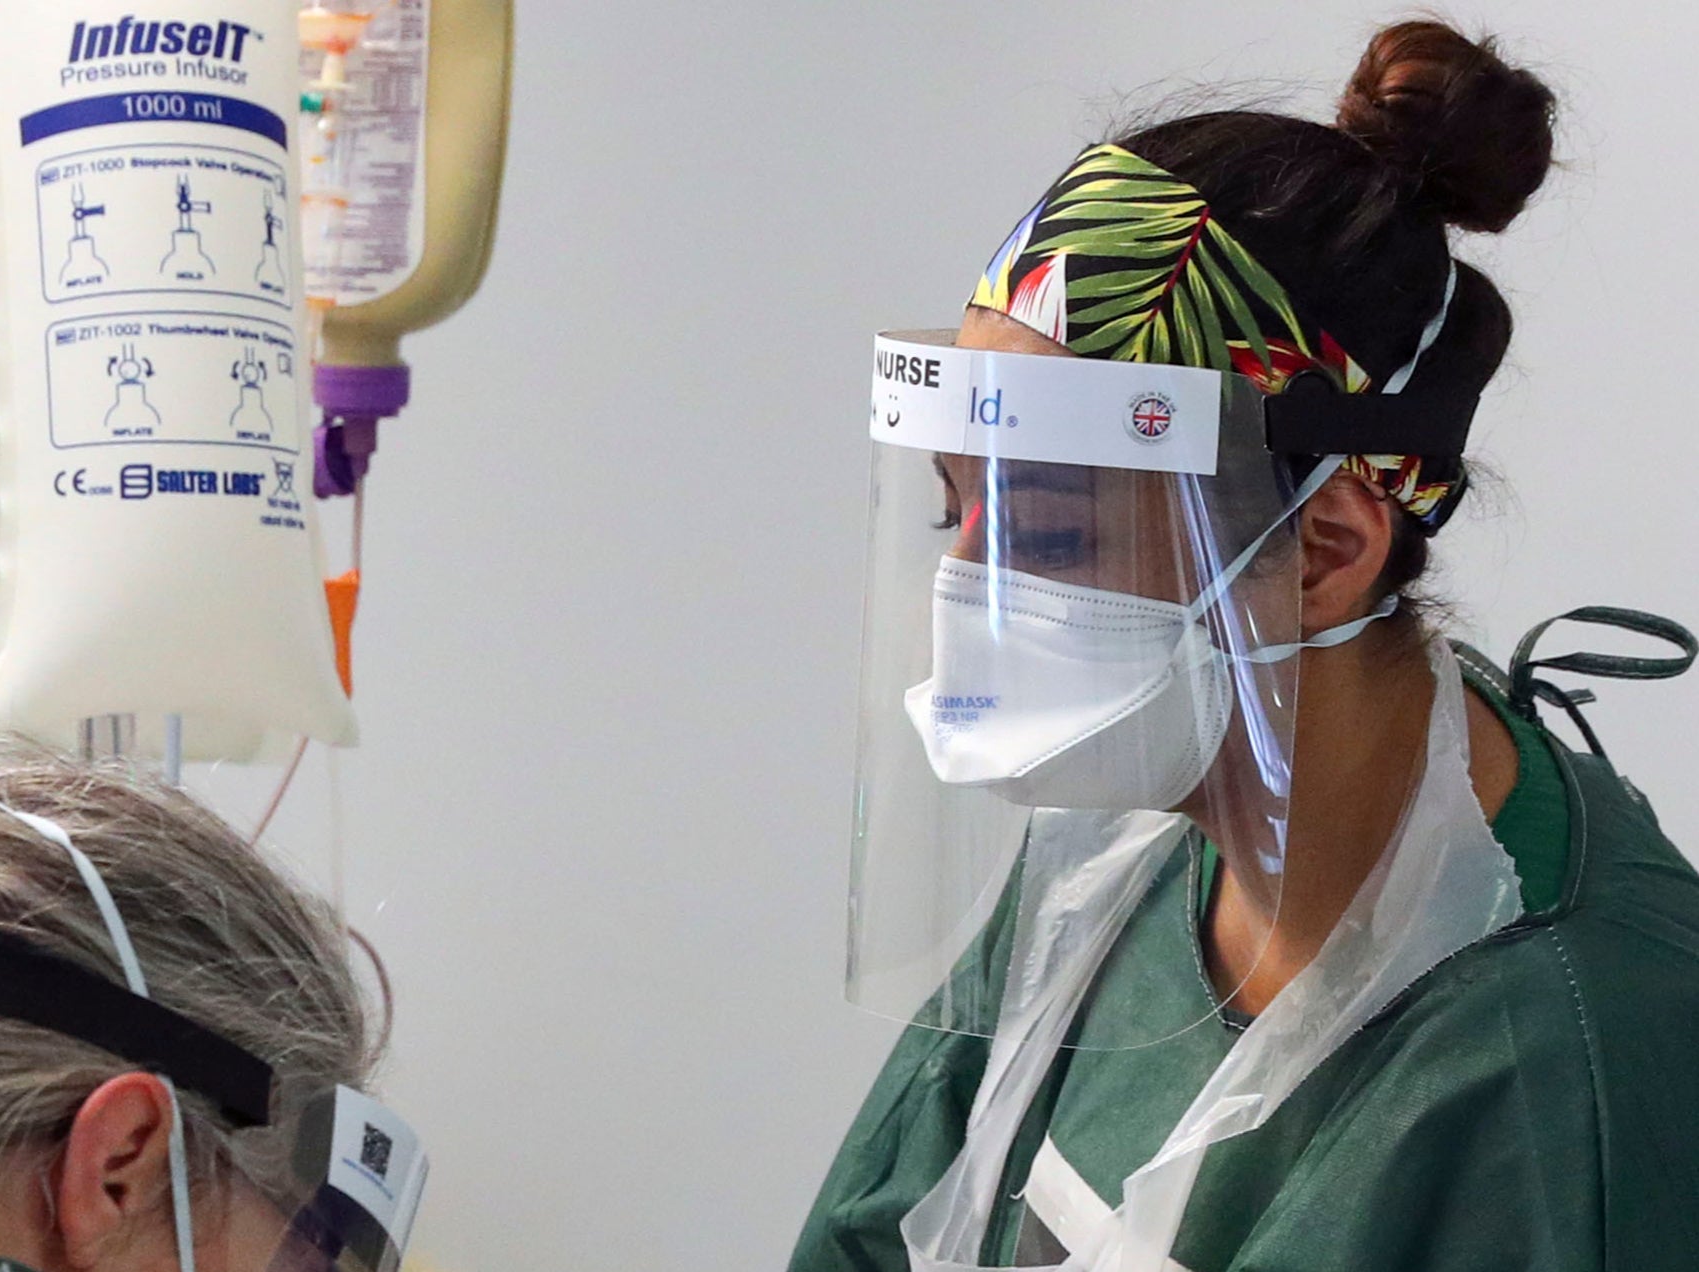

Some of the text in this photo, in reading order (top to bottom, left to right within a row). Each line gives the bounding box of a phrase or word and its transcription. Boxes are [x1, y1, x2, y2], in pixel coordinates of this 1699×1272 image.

[69, 15, 250, 63] InfuseIT
[60, 58, 249, 87] Pressure Infusor
[122, 95, 222, 119] 1000 ml
[62, 157, 125, 179] ZIT-1000
[78, 323, 141, 341] ZIT-1002
[876, 349, 941, 388] NURSE
[157, 470, 261, 496] SALTER LABS
